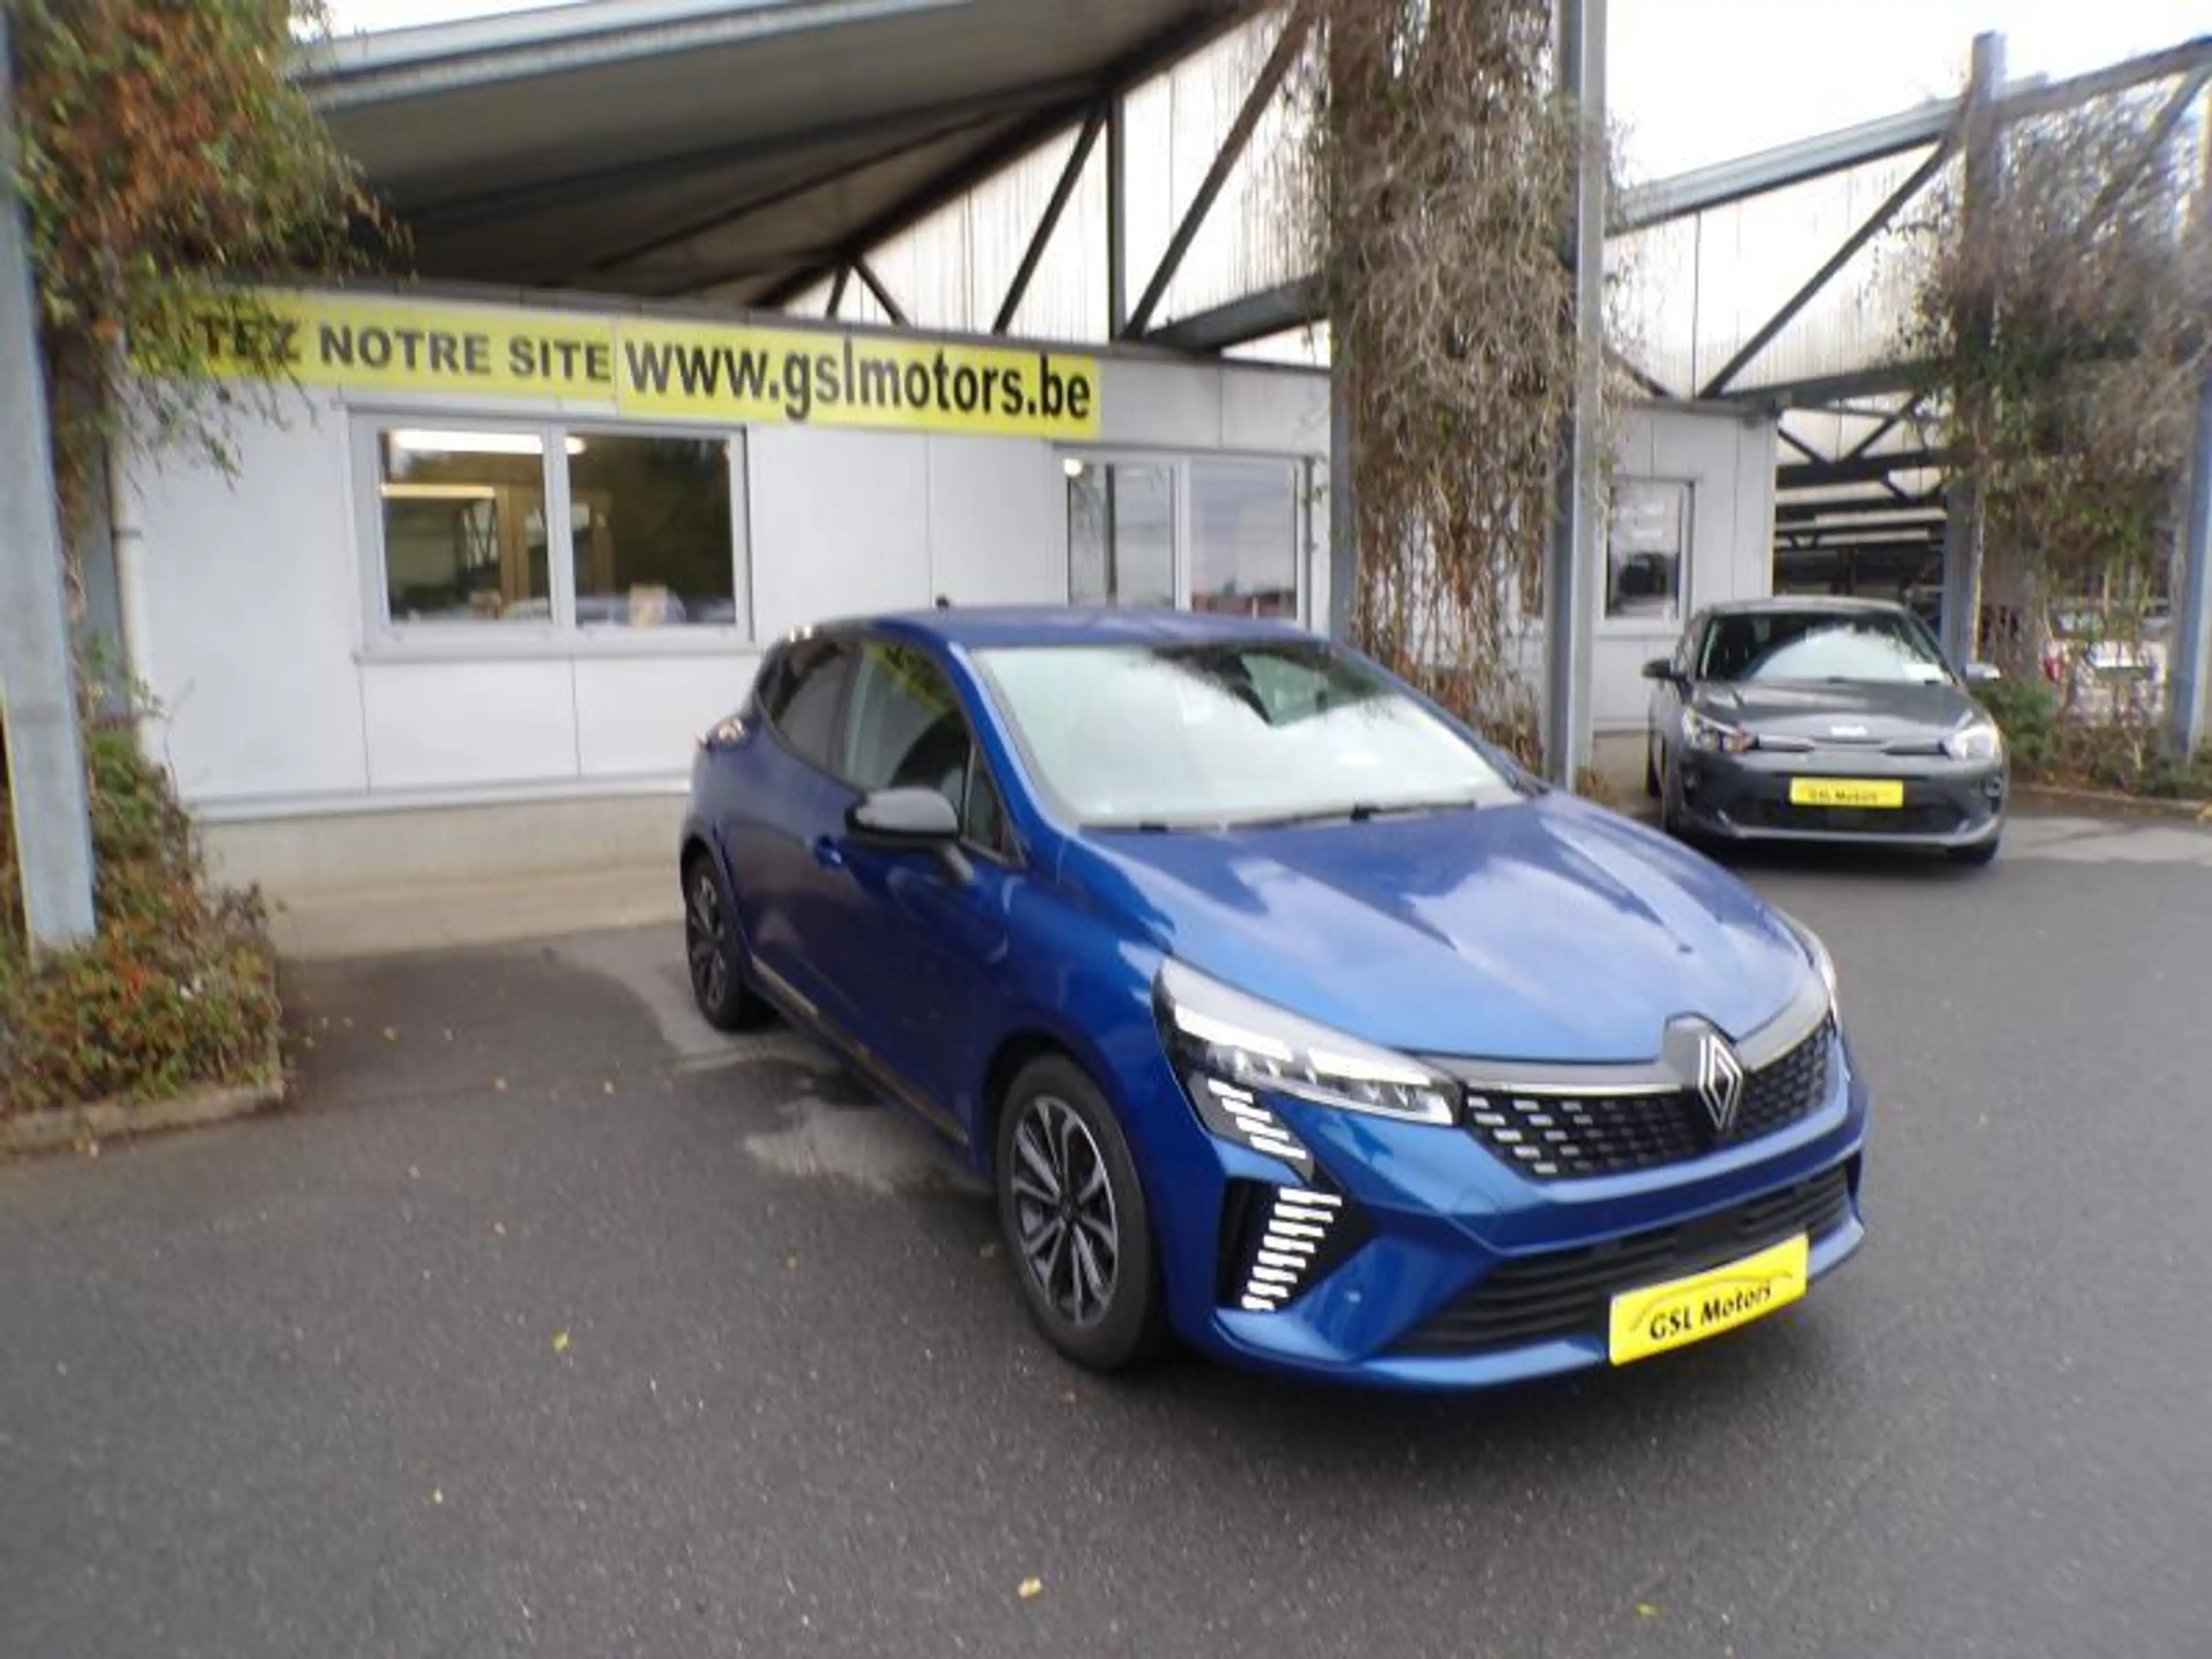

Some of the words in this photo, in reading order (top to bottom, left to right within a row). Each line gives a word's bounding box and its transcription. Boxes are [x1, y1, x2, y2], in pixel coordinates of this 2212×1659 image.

[320, 324, 491, 374] NOTRE
[509, 336, 612, 381] SITE
[624, 340, 1091, 421] www.gslmotors.be
[1650, 1304, 1694, 1339] GSL
[1700, 1279, 1772, 1325] Motors
